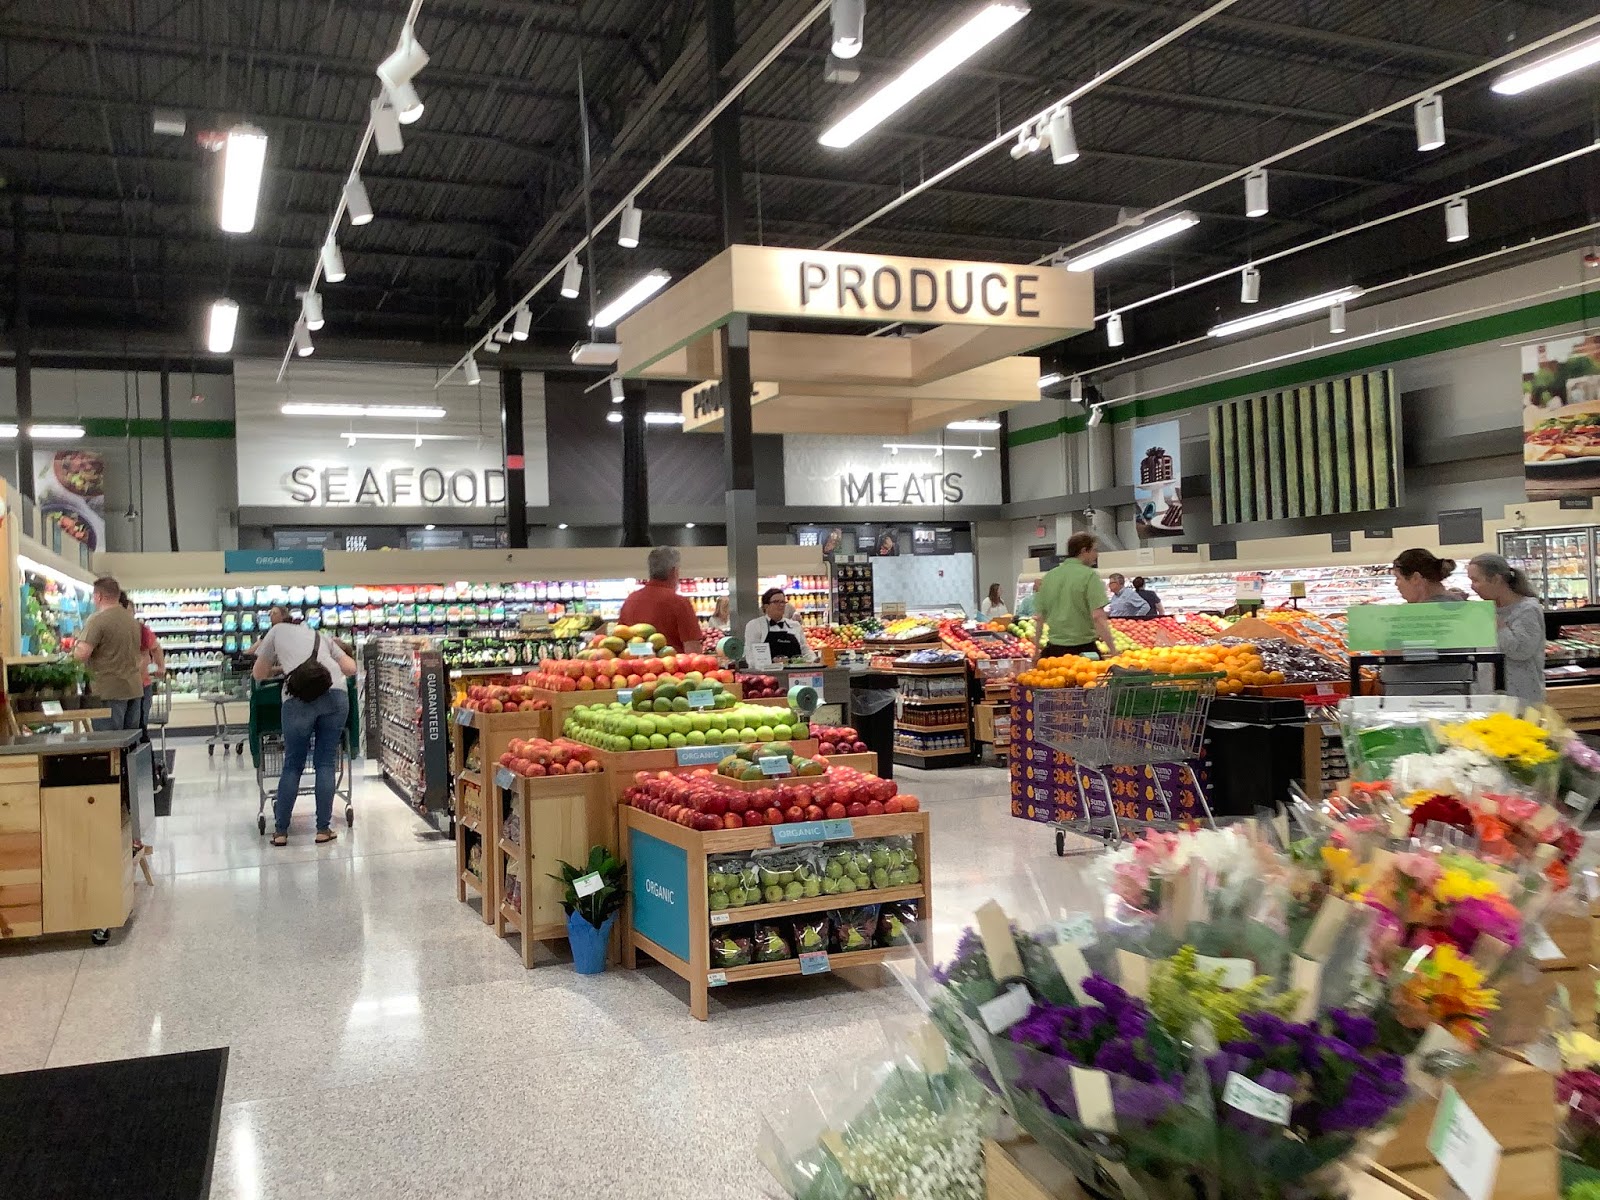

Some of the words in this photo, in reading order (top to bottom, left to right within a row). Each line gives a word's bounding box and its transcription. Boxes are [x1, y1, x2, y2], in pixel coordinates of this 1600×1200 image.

[800, 260, 1040, 318] PRODUCE
[291, 465, 505, 503] SEAFOOD
[847, 472, 963, 503] MEATS
[255, 556, 294, 565] ORGANIC
[427, 673, 439, 741] GUARANTEED
[681, 751, 719, 760] ORGANIC
[779, 827, 821, 838] ORGANIC
[645, 879, 675, 905] ORGANIC
